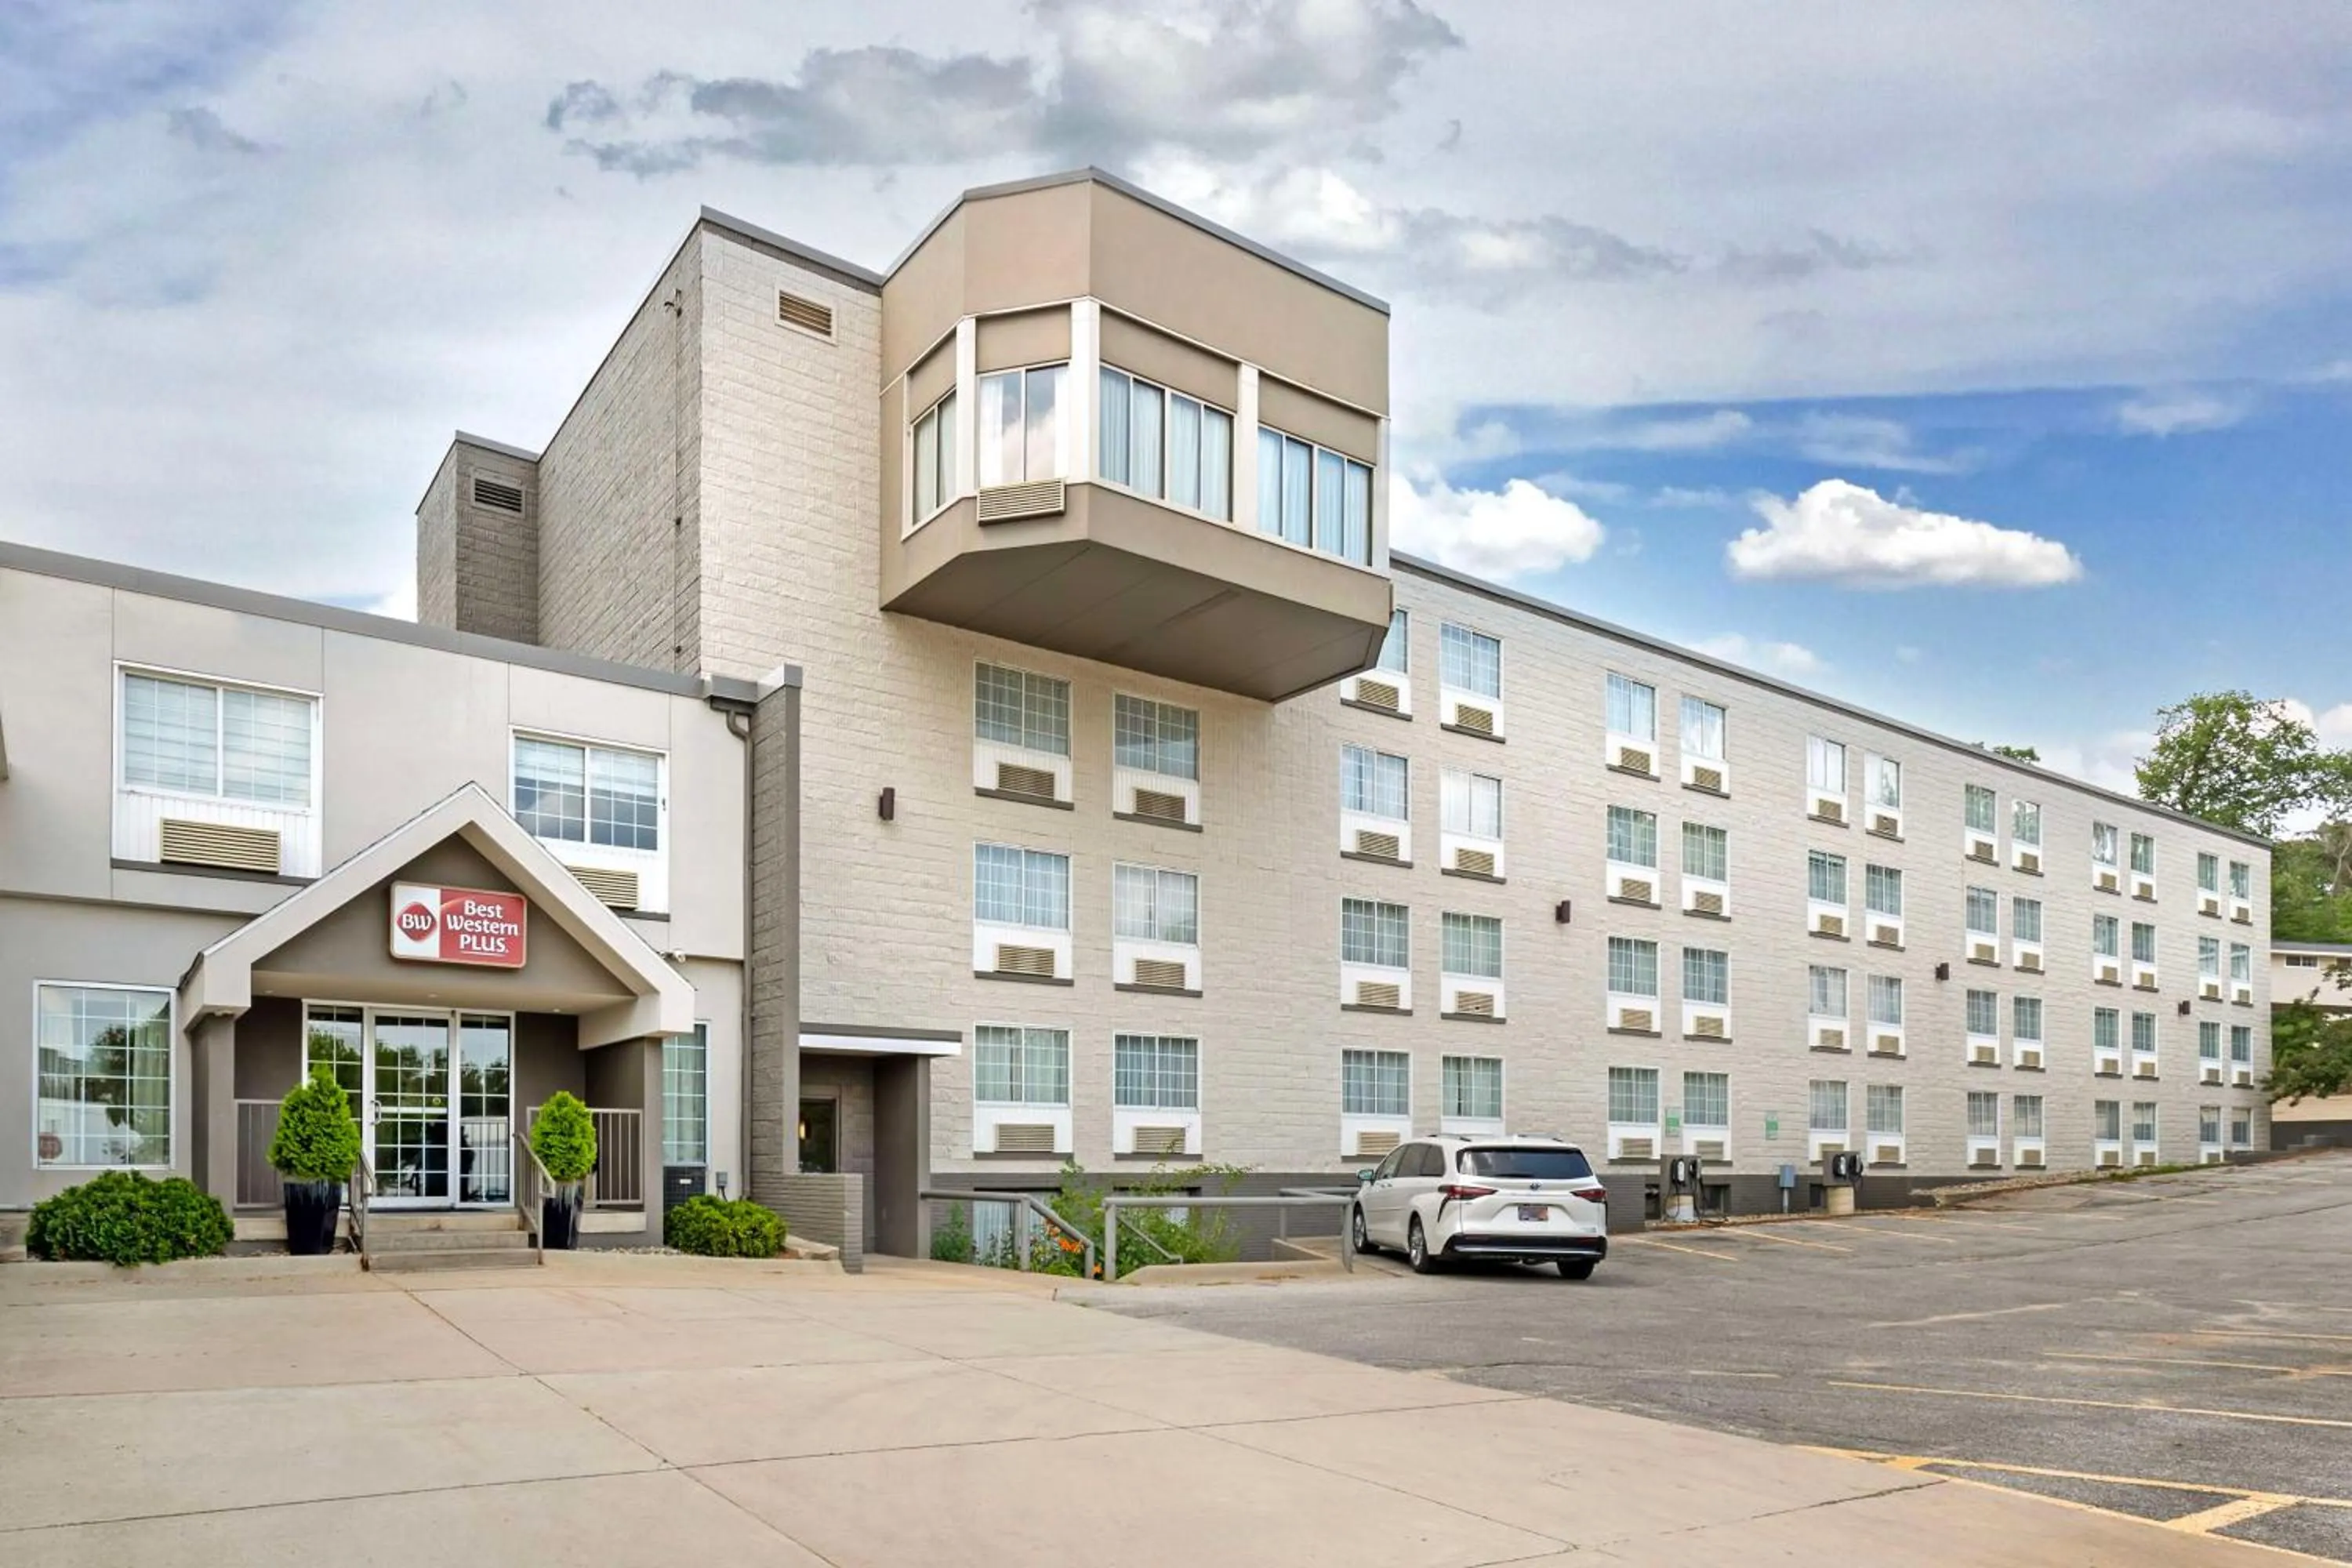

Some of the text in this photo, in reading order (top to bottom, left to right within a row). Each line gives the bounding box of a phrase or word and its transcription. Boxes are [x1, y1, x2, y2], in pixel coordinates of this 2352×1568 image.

[463, 900, 503, 919] Best
[401, 913, 432, 931] BW
[446, 914, 518, 936] Western
[459, 934, 506, 953] PLUS
